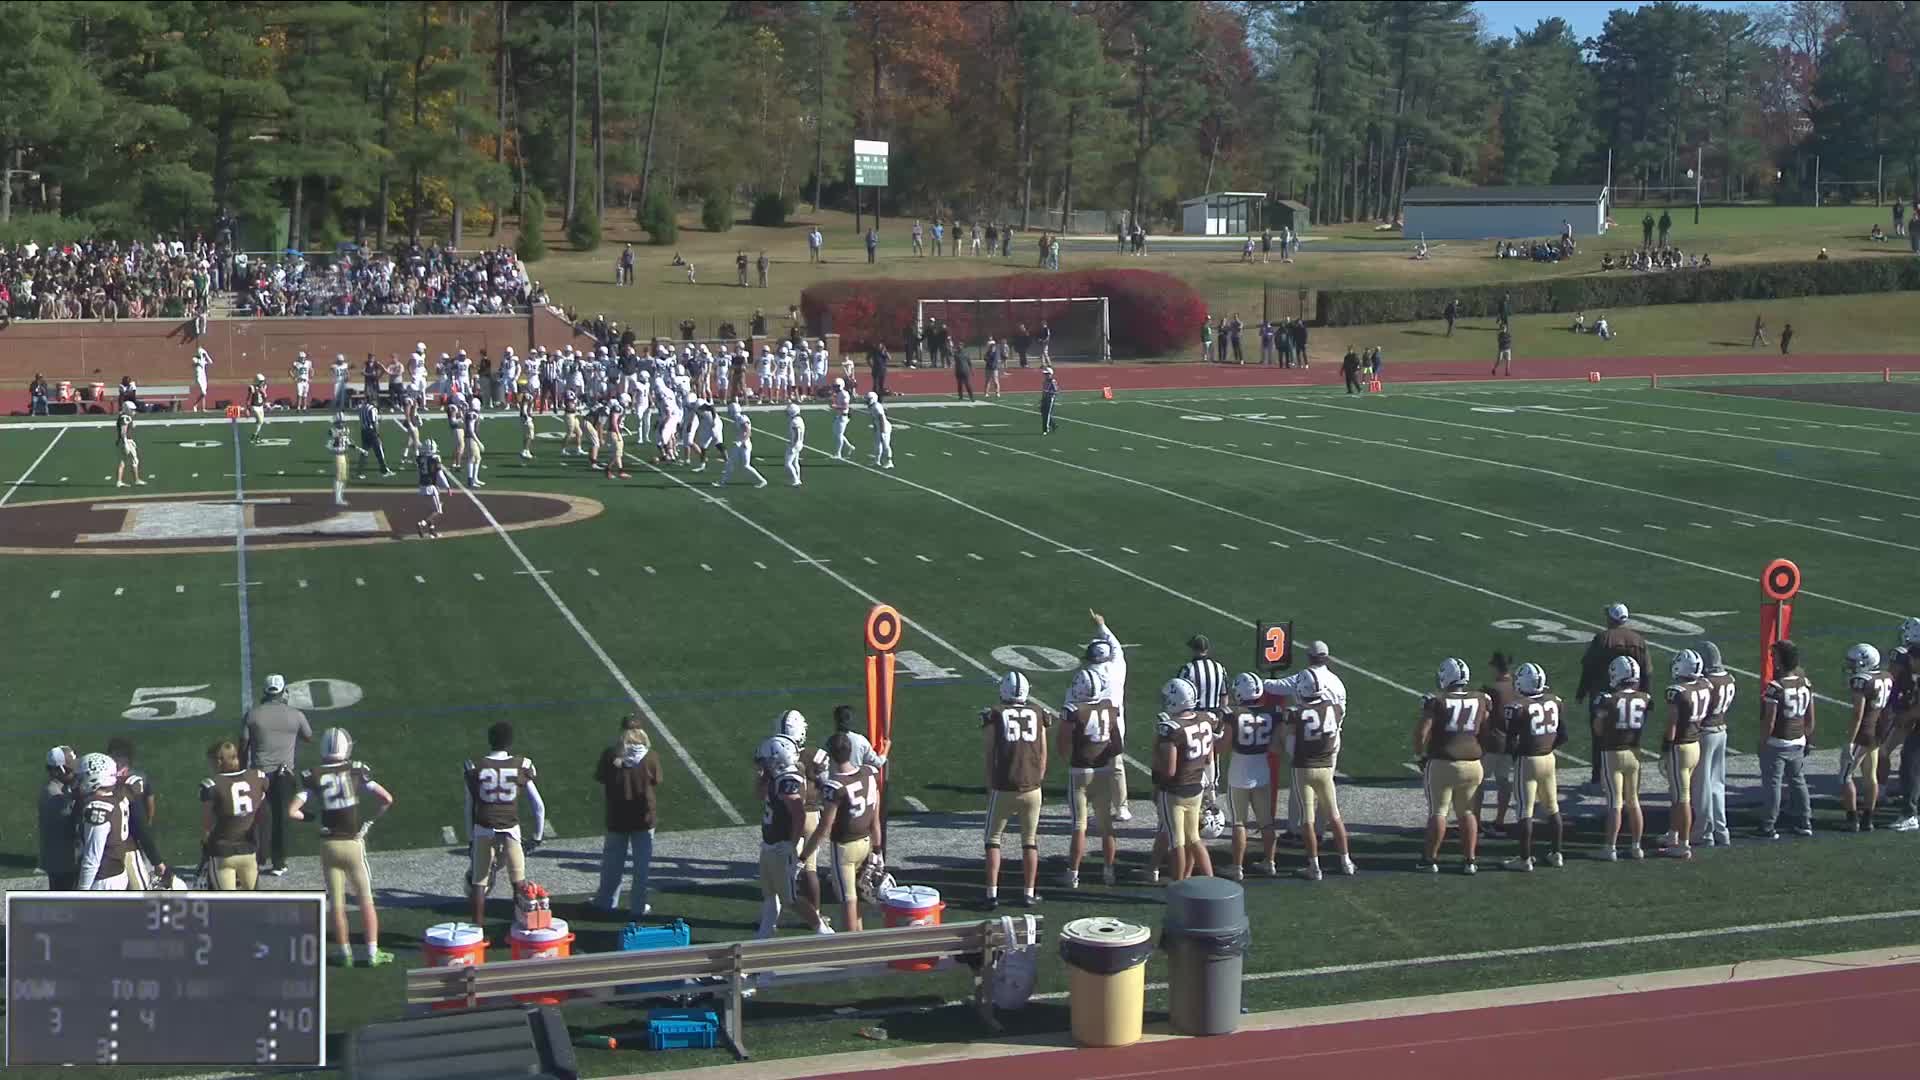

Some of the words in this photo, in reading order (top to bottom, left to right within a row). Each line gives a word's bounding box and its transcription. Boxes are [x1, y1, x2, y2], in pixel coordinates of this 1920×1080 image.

[1264, 626, 1285, 662] 3
[121, 679, 363, 720] 50
[1445, 698, 1479, 732] 77
[1616, 697, 1647, 730] 16
[1689, 688, 1711, 722] 17
[1784, 686, 1811, 719] 50
[1002, 709, 1037, 742] 63
[1084, 709, 1111, 742] 41
[1238, 713, 1273, 746] 62
[1301, 706, 1338, 741] 24
[1528, 701, 1559, 735] 23
[1184, 721, 1213, 760] 52
[231, 782, 254, 817] 6
[319, 772, 358, 811] 21
[479, 768, 519, 802] 25
[845, 775, 879, 818] 54
